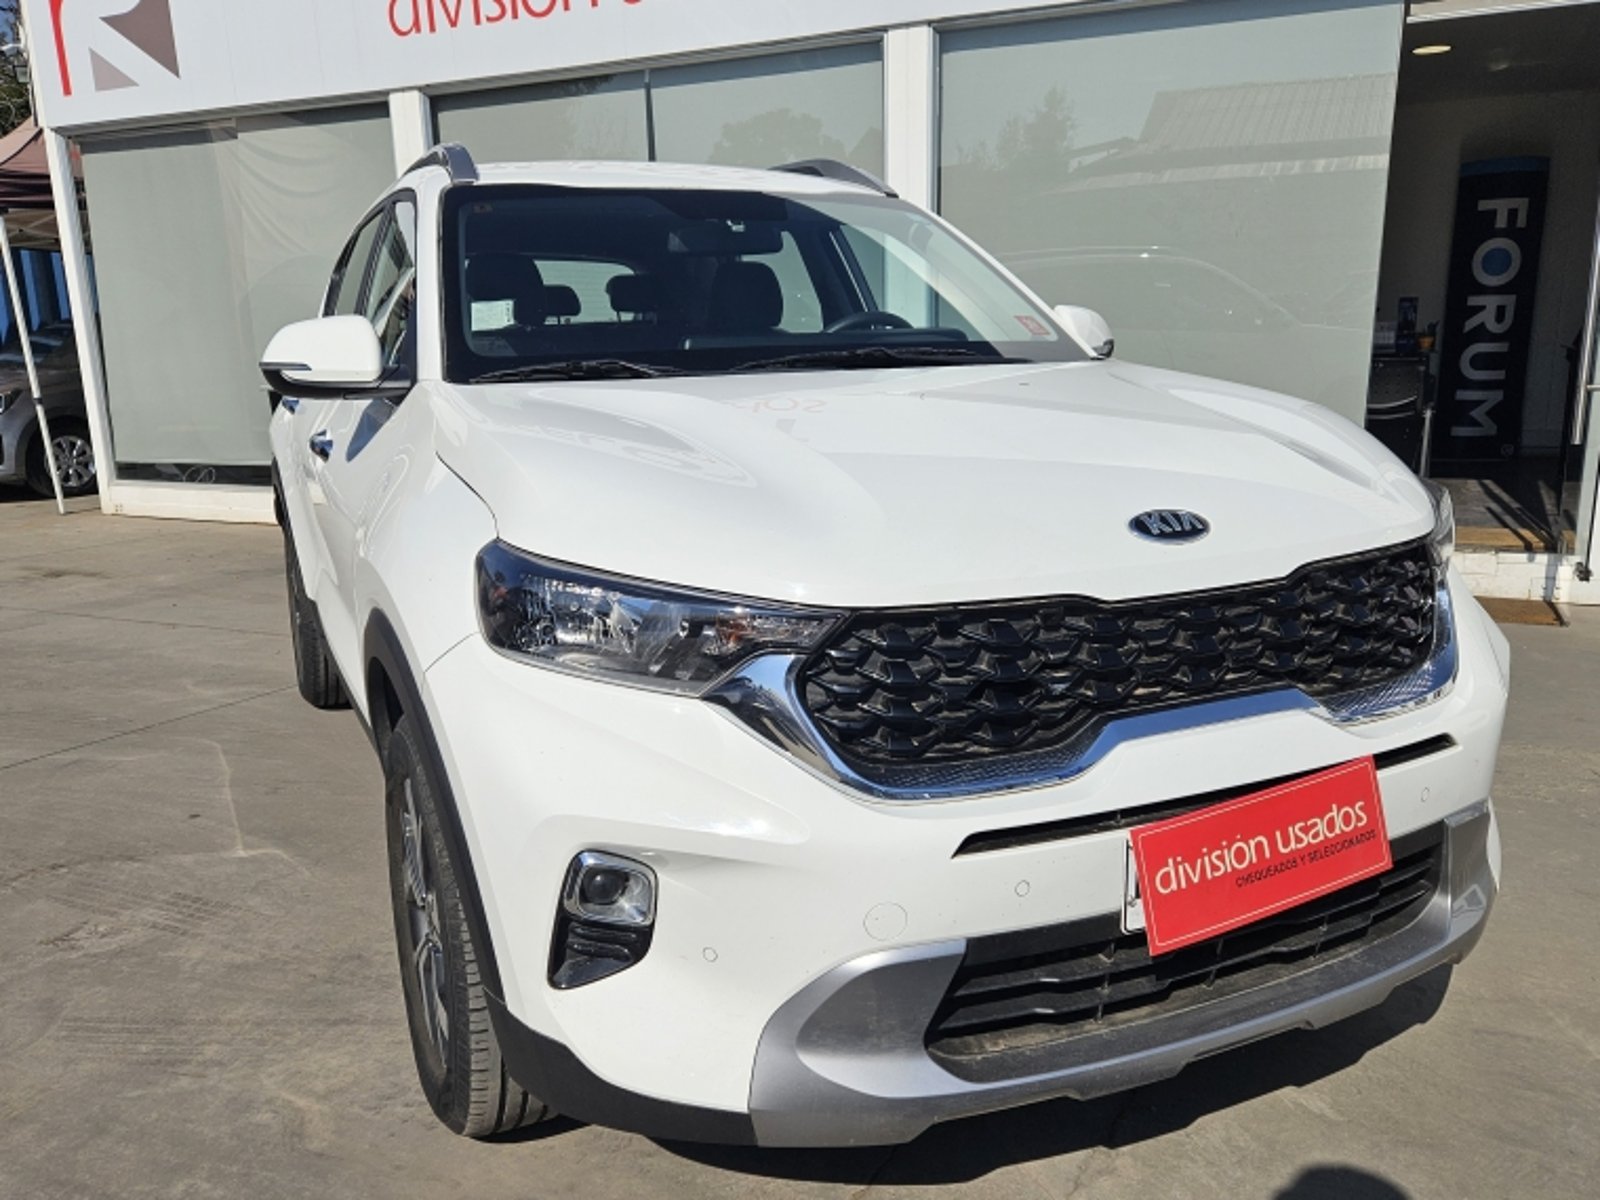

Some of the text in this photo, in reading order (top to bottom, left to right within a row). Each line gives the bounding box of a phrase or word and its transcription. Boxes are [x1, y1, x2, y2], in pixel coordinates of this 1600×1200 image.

[1451, 197, 1530, 436] FORUM
[1140, 510, 1204, 536] KIA
[1154, 800, 1368, 895] división usados
[1235, 858, 1298, 888] CHEQUEADOS
[1308, 829, 1377, 864] SELECCIONADOS
